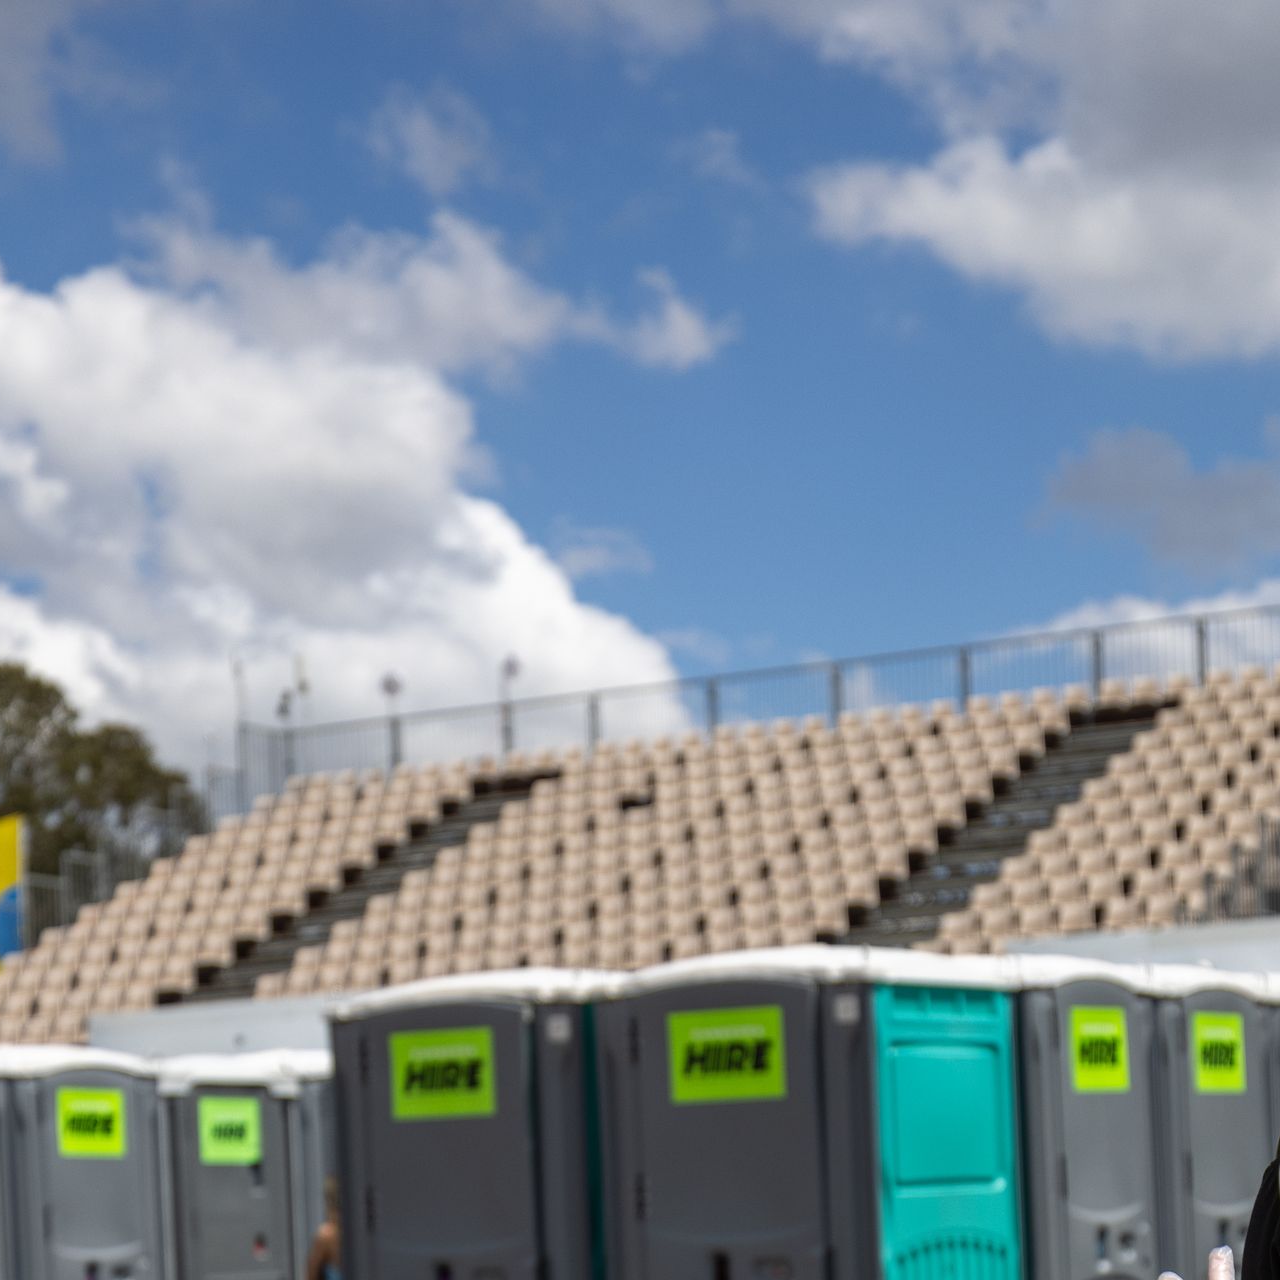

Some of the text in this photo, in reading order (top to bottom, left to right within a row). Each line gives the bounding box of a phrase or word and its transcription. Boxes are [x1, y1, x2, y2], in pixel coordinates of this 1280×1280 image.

[684, 1039, 772, 1076] HIRE
[1079, 1038, 1120, 1067] HIRE
[1200, 1042, 1237, 1069] HIRE
[404, 1059, 483, 1093] HIRE
[66, 1113, 115, 1137] HIRE
